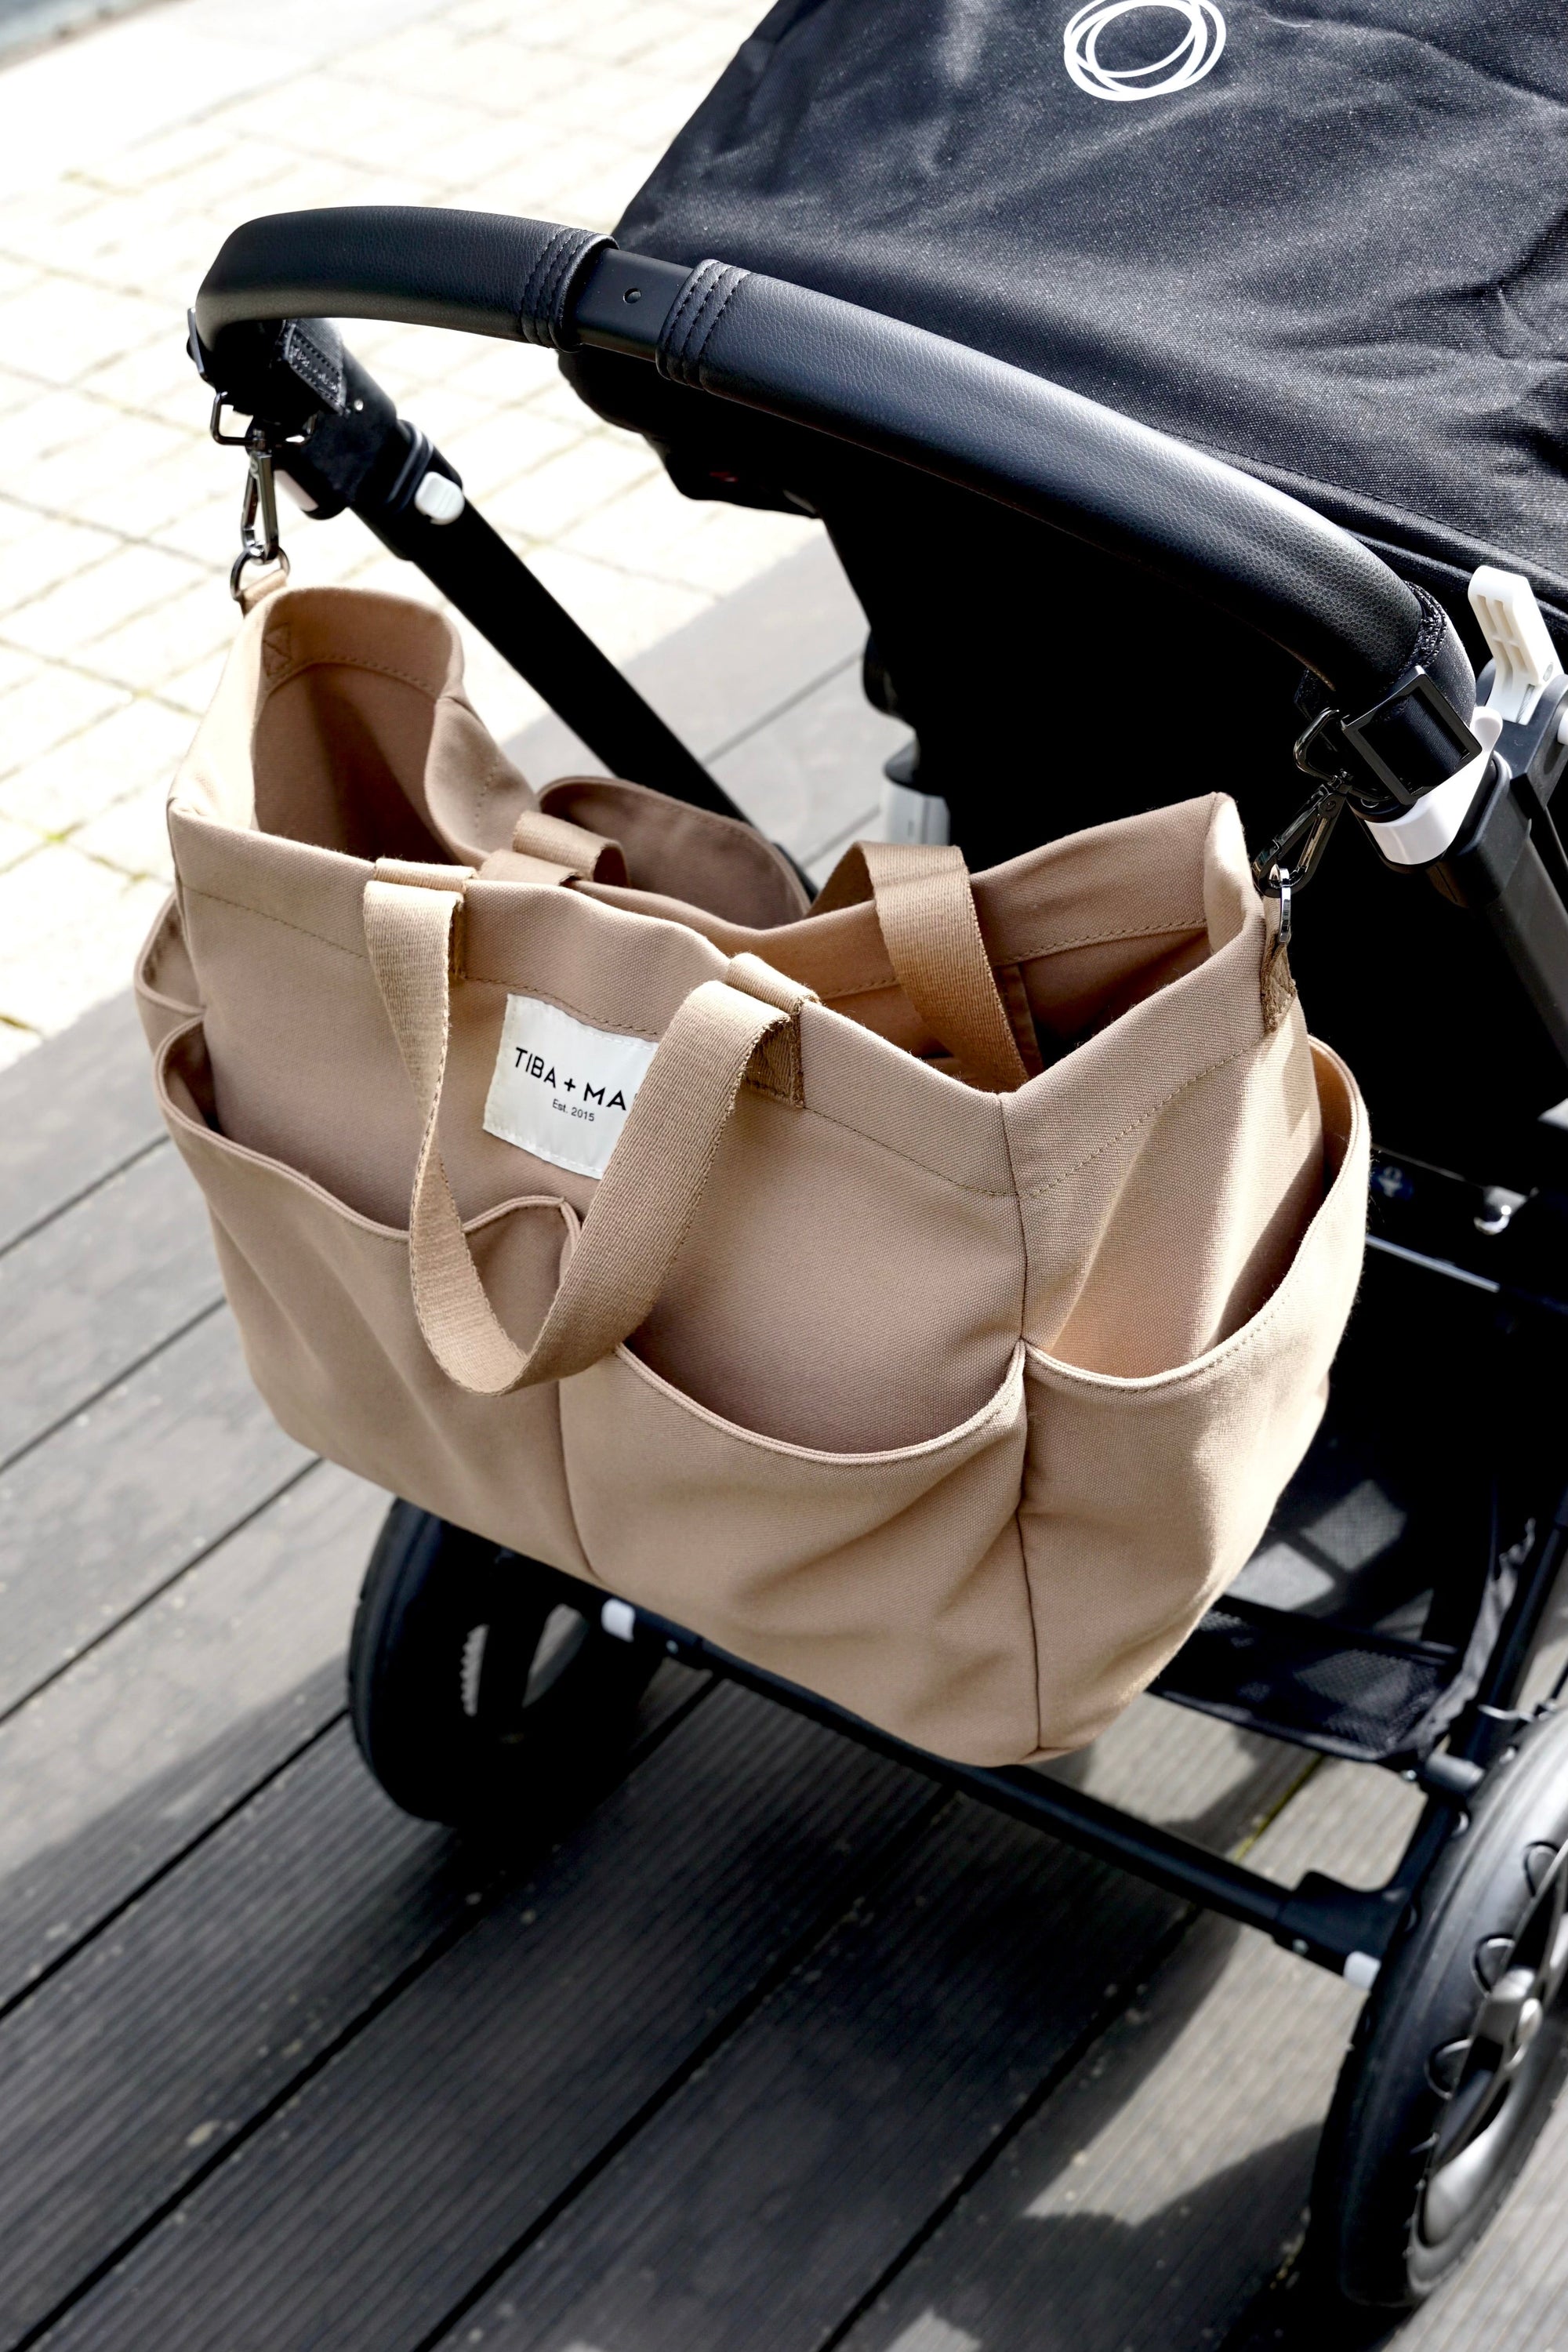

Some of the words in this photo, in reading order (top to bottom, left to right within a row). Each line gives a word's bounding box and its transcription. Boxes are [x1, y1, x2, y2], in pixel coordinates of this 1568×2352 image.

[515, 1047, 557, 1089] TIBA
[564, 1078, 576, 1092] +
[583, 1082, 637, 1111] MA
[552, 1098, 568, 1113] Est.
[571, 1106, 594, 1122] 2015
